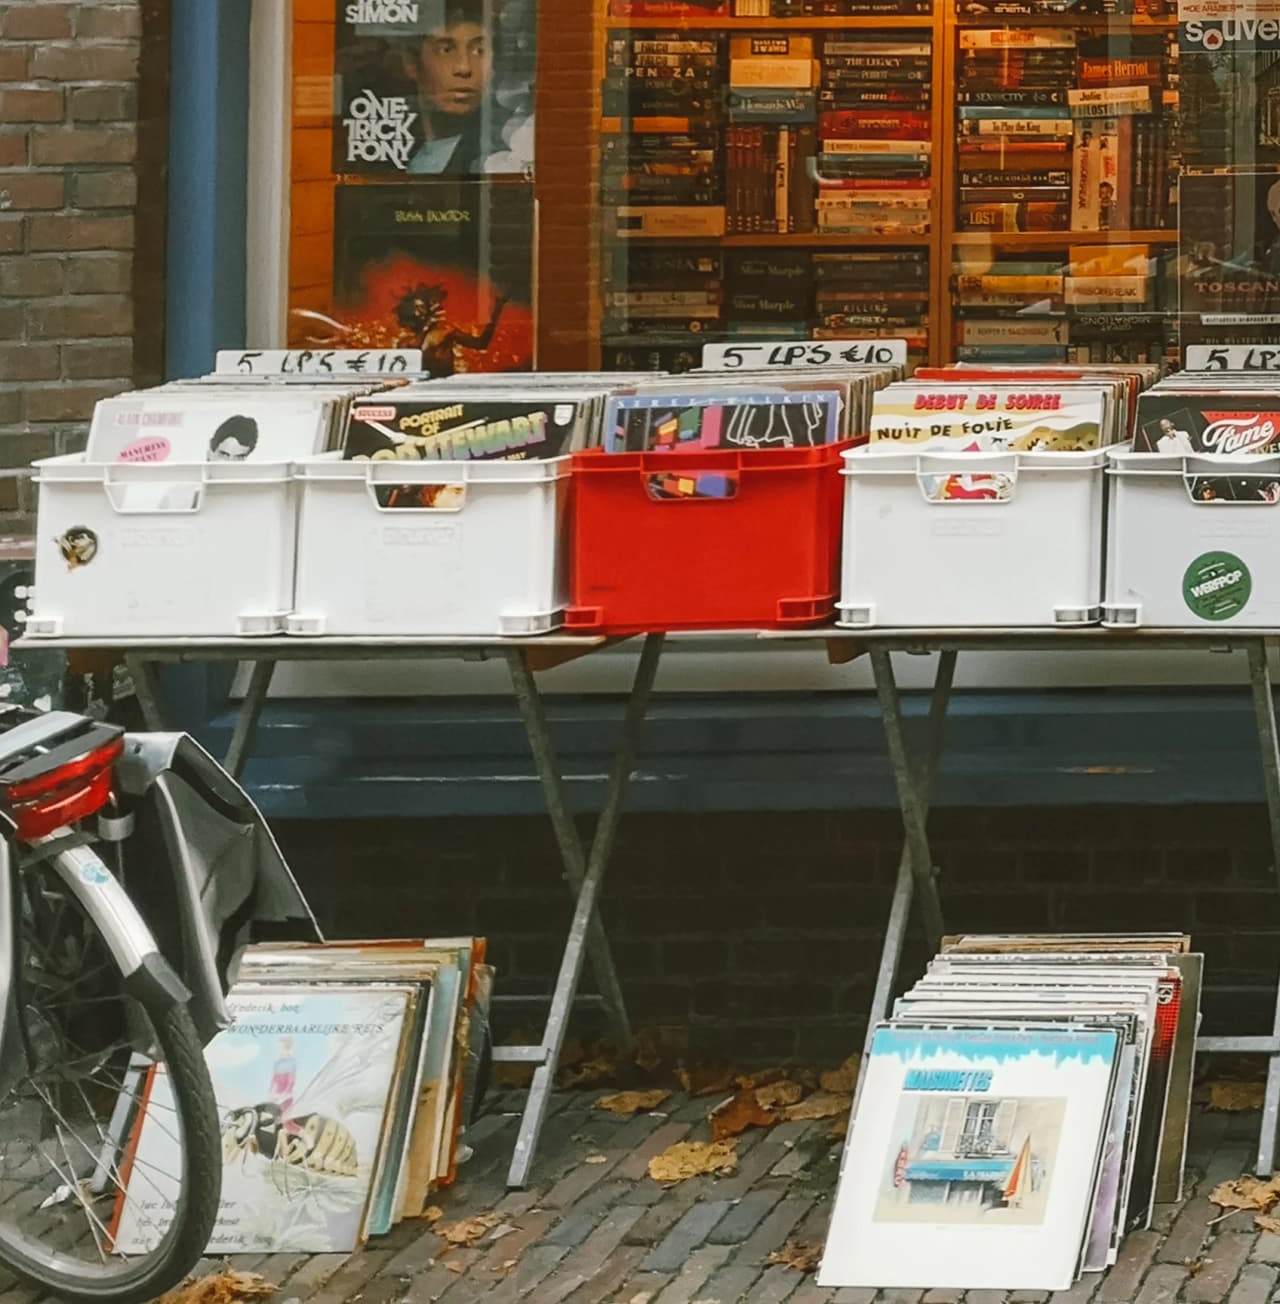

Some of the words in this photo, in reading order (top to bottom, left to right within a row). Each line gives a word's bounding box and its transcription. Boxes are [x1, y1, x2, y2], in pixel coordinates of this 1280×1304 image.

[345, 3, 419, 24] SIMON
[1083, 62, 1113, 79] James
[1114, 60, 1149, 78] Herriot
[343, 111, 418, 142] TRICK
[347, 139, 415, 170] PONY
[969, 211, 996, 225] LOST
[724, 347, 763, 368] 5
[914, 394, 969, 411] DEBUT
[975, 394, 997, 411] DE
[400, 404, 465, 431] PORTRAIT
[421, 423, 440, 436] OF
[930, 424, 952, 436] DE
[1201, 414, 1276, 454] Fame
